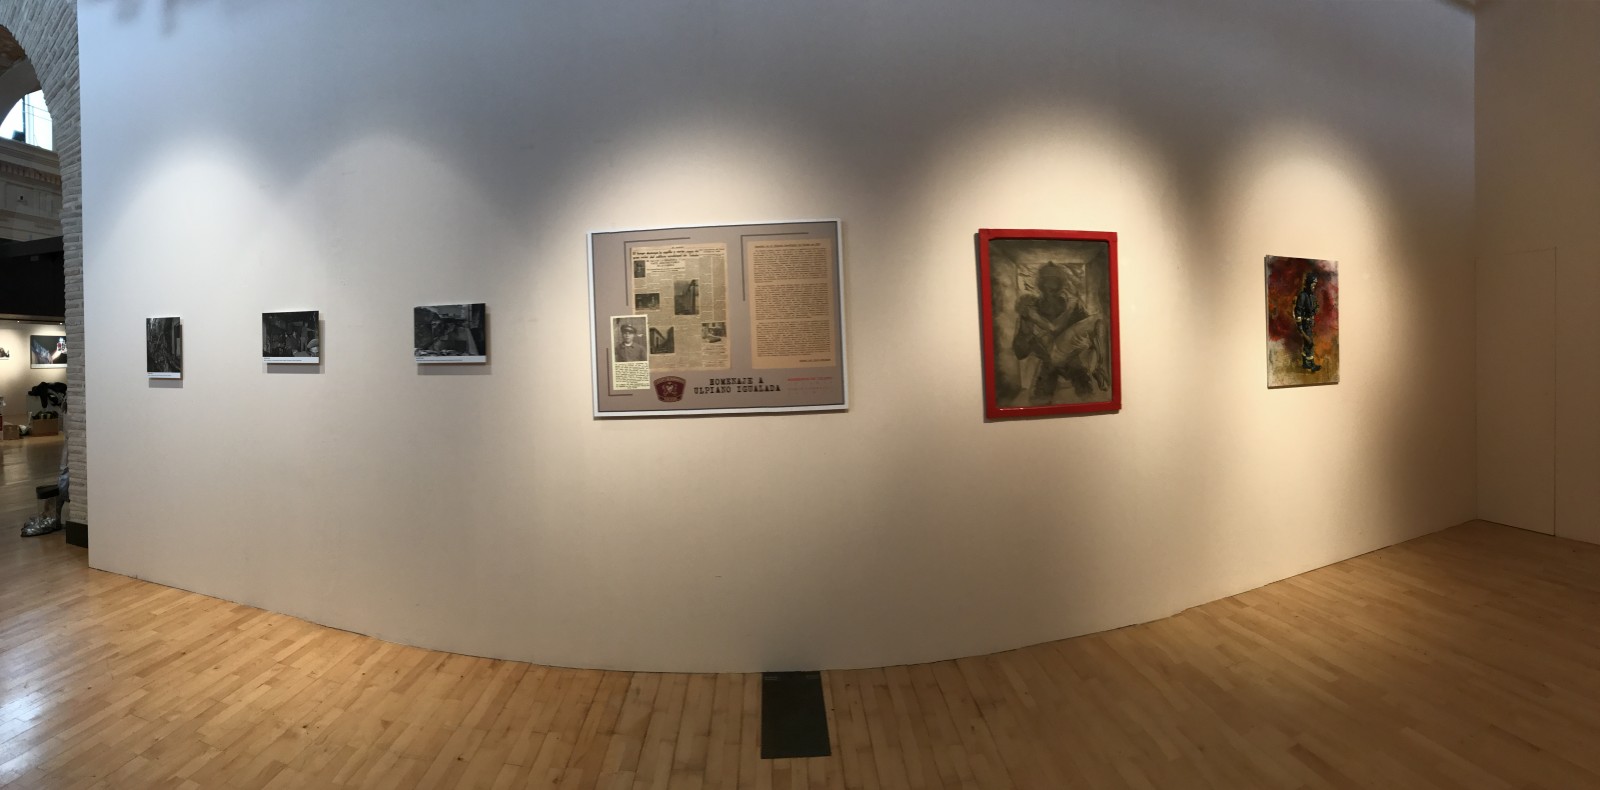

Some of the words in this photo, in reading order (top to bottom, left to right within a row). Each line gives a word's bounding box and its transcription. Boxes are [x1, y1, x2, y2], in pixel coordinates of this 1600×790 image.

[709, 377, 753, 386] HOMENAJE
[693, 386, 732, 394] ULPIANO
[736, 384, 781, 392] IGUALADA
